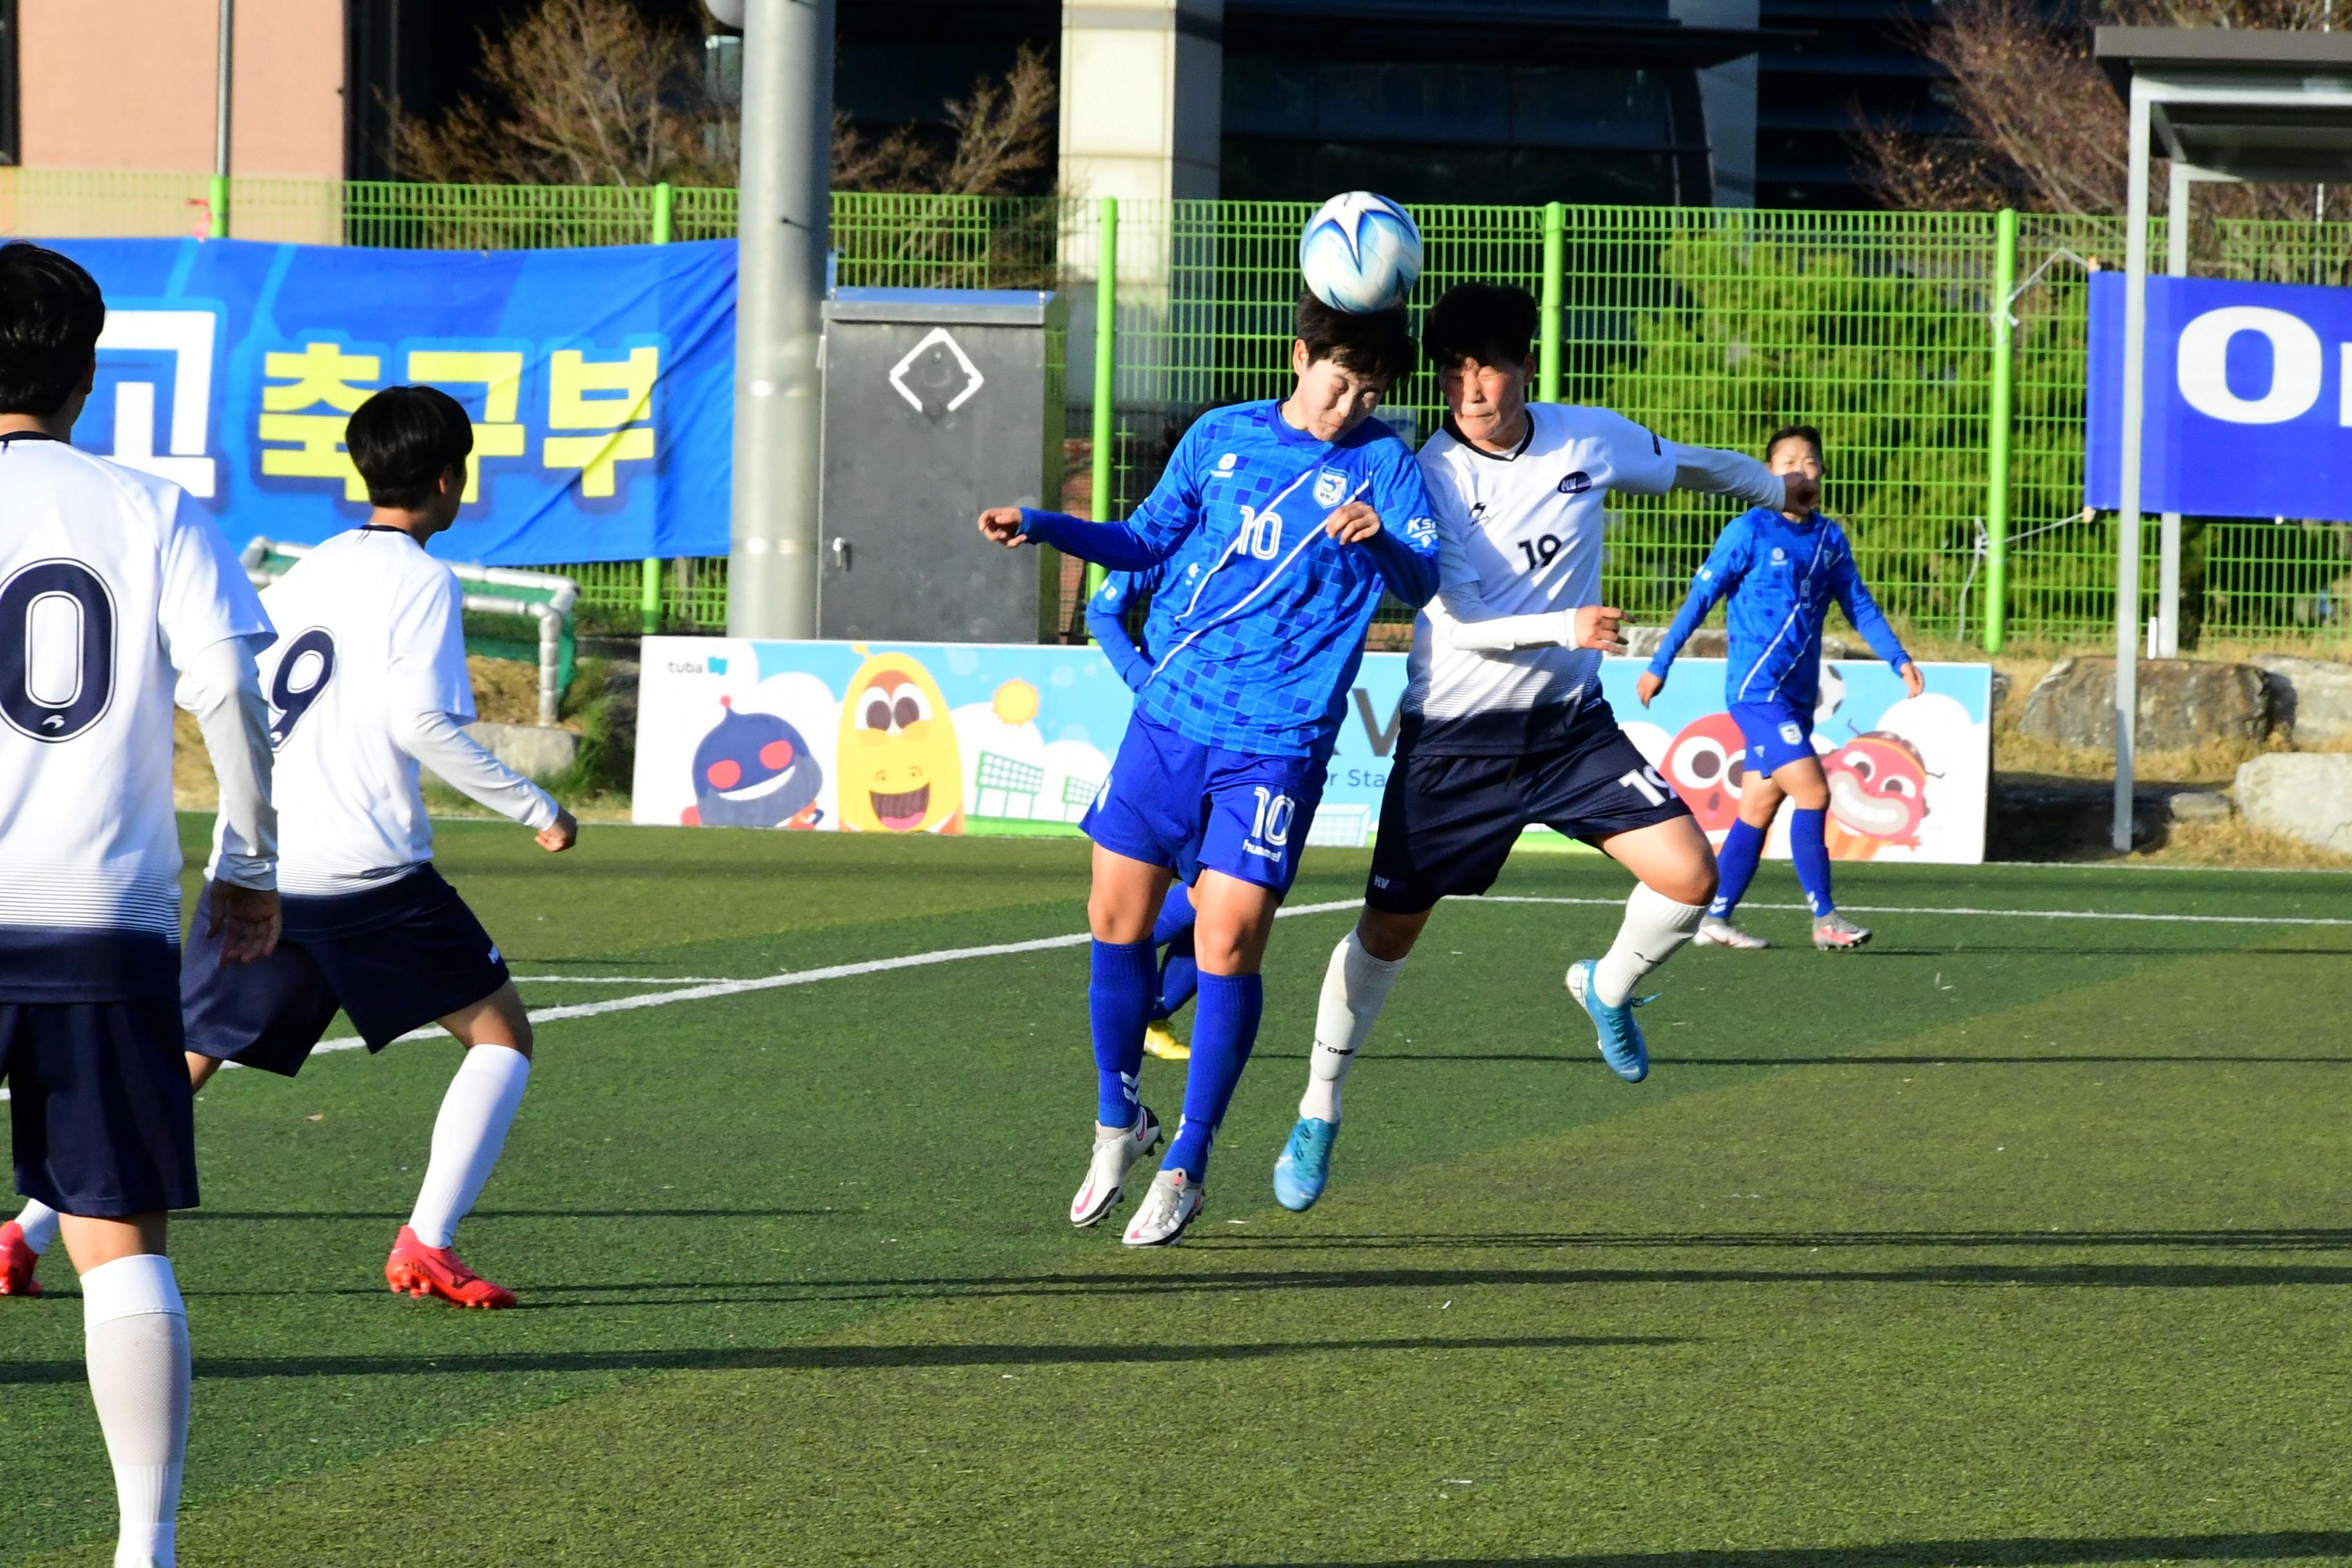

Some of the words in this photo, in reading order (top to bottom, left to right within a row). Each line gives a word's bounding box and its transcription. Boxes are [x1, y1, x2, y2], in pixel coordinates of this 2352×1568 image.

[259, 342, 658, 503] 축구부
[1237, 505, 1282, 560] 10
[1518, 534, 1562, 570] 19
[268, 625, 337, 753] 9
[668, 662, 703, 674] tuba
[1347, 769, 1386, 788] Sta
[1251, 786, 1295, 846] 10
